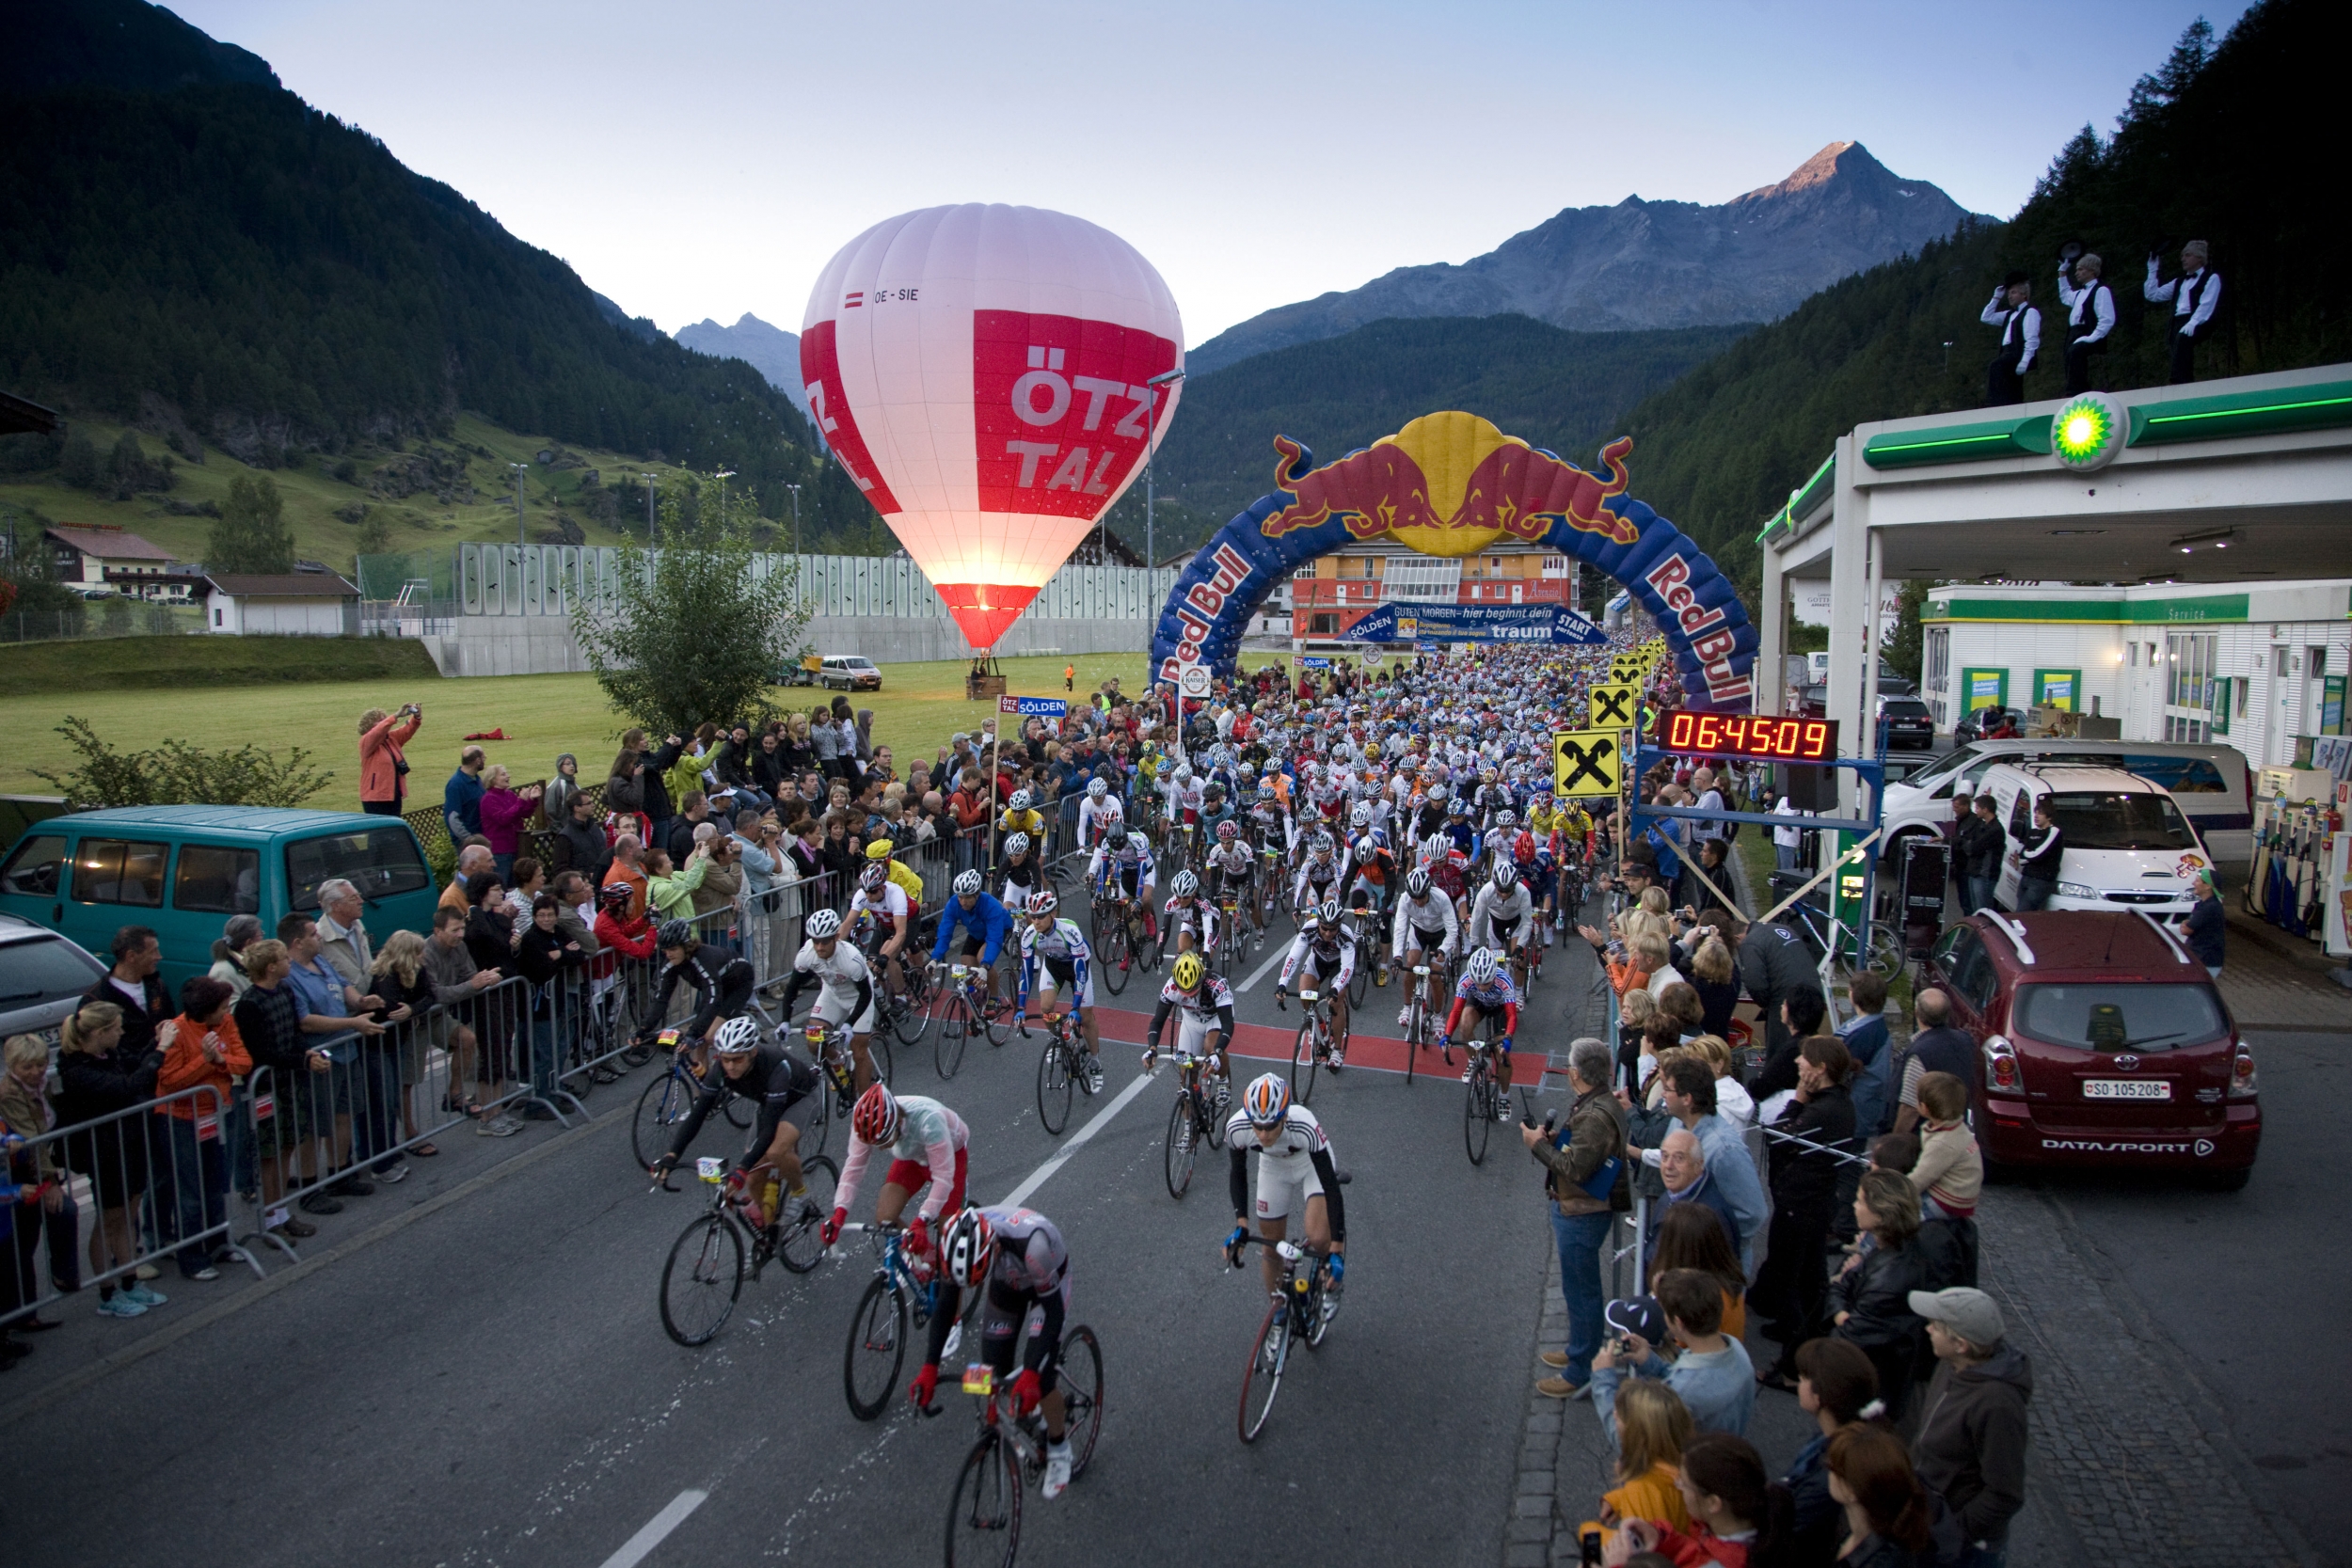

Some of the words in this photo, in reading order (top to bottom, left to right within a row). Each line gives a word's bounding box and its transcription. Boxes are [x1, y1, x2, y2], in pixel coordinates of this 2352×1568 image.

[898, 288, 919, 301] SIE
[1011, 345, 1159, 440] ÖTZ
[1006, 439, 1118, 496] TAL
[1184, 542, 1253, 620] Bull
[1645, 552, 1726, 637] Red
[1394, 607, 1420, 617] GUTEN
[1486, 608, 1526, 621] beginnt
[1529, 607, 1552, 618] dein
[2169, 609, 2204, 620] Service
[1350, 616, 1392, 639] SÖLDEN
[1491, 625, 1552, 639] traum
[1557, 613, 1592, 636] START
[1555, 626, 1584, 641] partenza
[1159, 607, 1213, 684] Red
[1304, 658, 1328, 667] SÖLDEN
[1690, 626, 1753, 704] Bull
[1002, 697, 1017, 705] ÖTZ
[1019, 701, 1065, 713] SÖLDEN
[1670, 714, 1827, 756] 06:45:09
[2042, 1139, 2190, 1152] DATASPORT
[1285, 1245, 1295, 1257] 15
